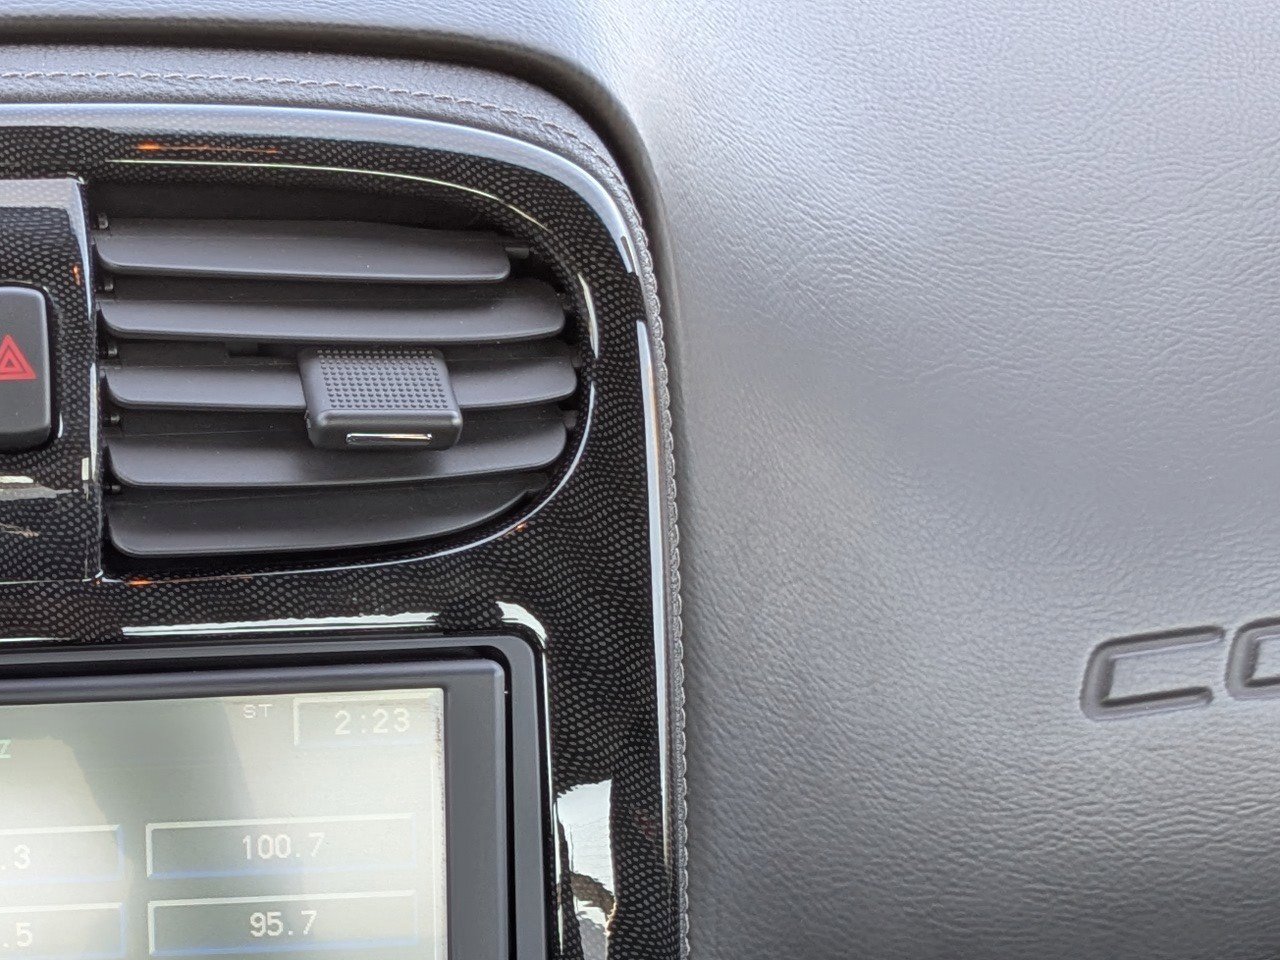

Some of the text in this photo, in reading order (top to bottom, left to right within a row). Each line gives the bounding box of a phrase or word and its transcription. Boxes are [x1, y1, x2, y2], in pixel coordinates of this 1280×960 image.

[242, 703, 273, 719] ST
[334, 707, 410, 735] 2:23
[242, 832, 325, 860] 100.7
[249, 910, 318, 937] 95.7
